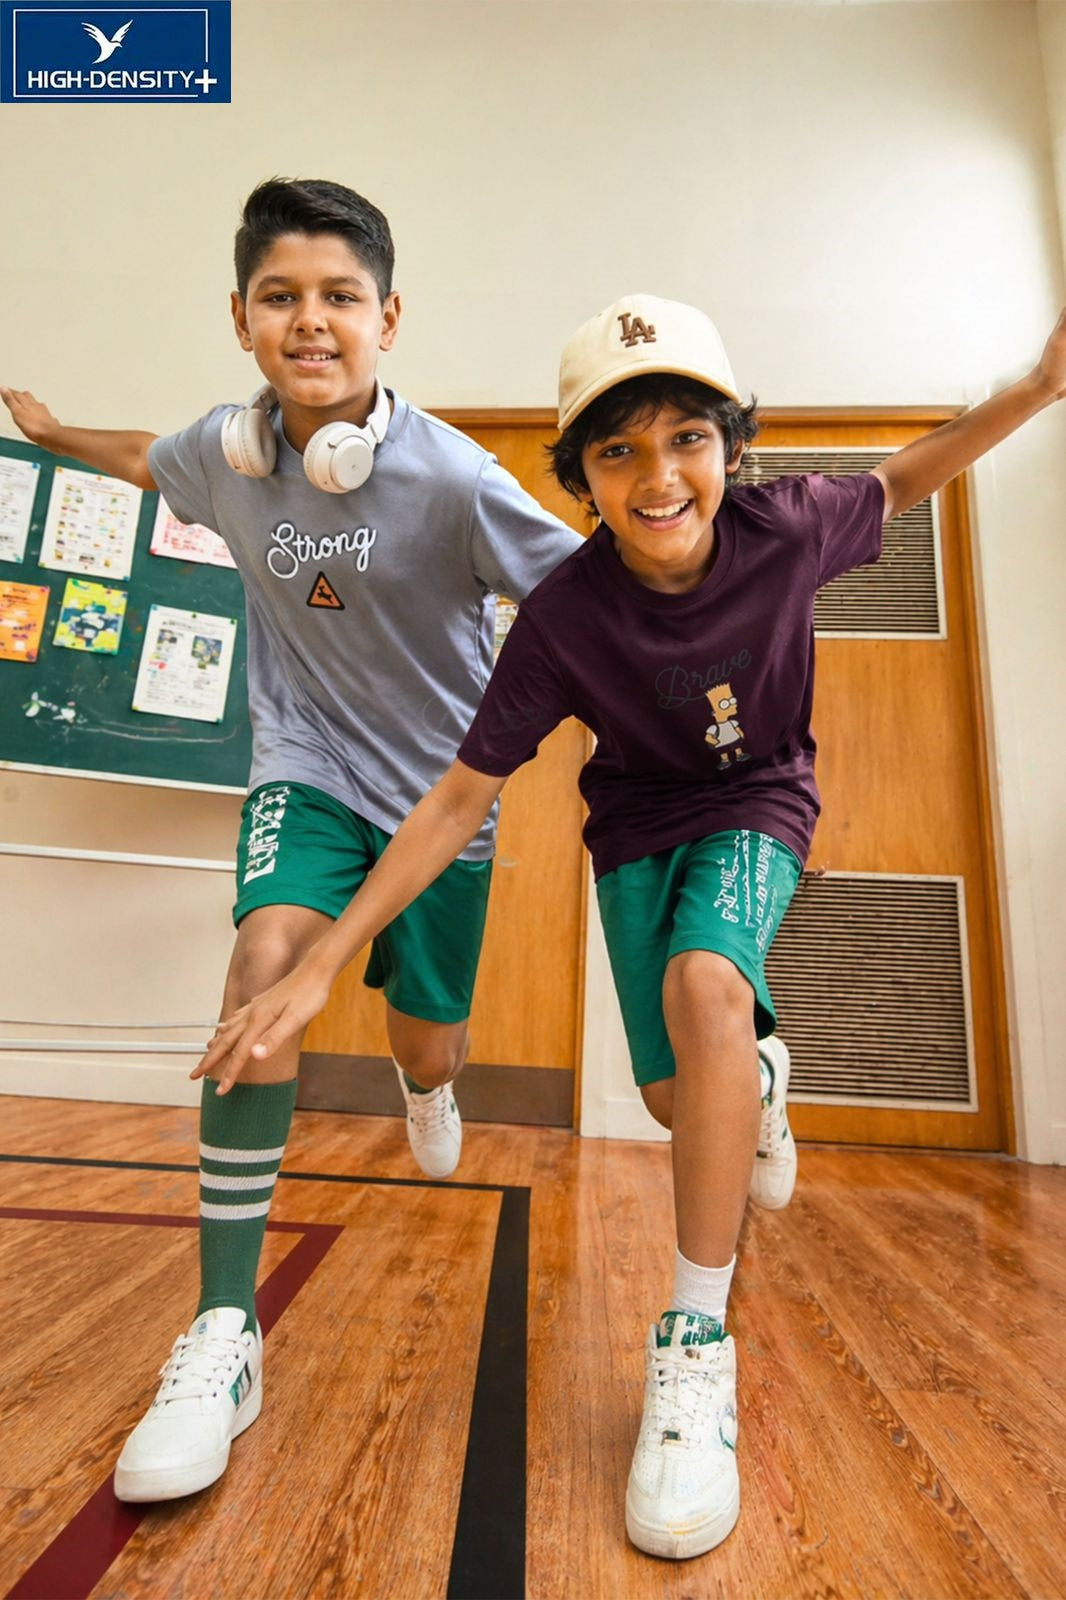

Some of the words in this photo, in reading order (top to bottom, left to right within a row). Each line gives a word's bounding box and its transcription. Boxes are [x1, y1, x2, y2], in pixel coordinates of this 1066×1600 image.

[617, 312, 657, 348] LA
[267, 523, 377, 580] Strong
[655, 648, 753, 710] Brave
